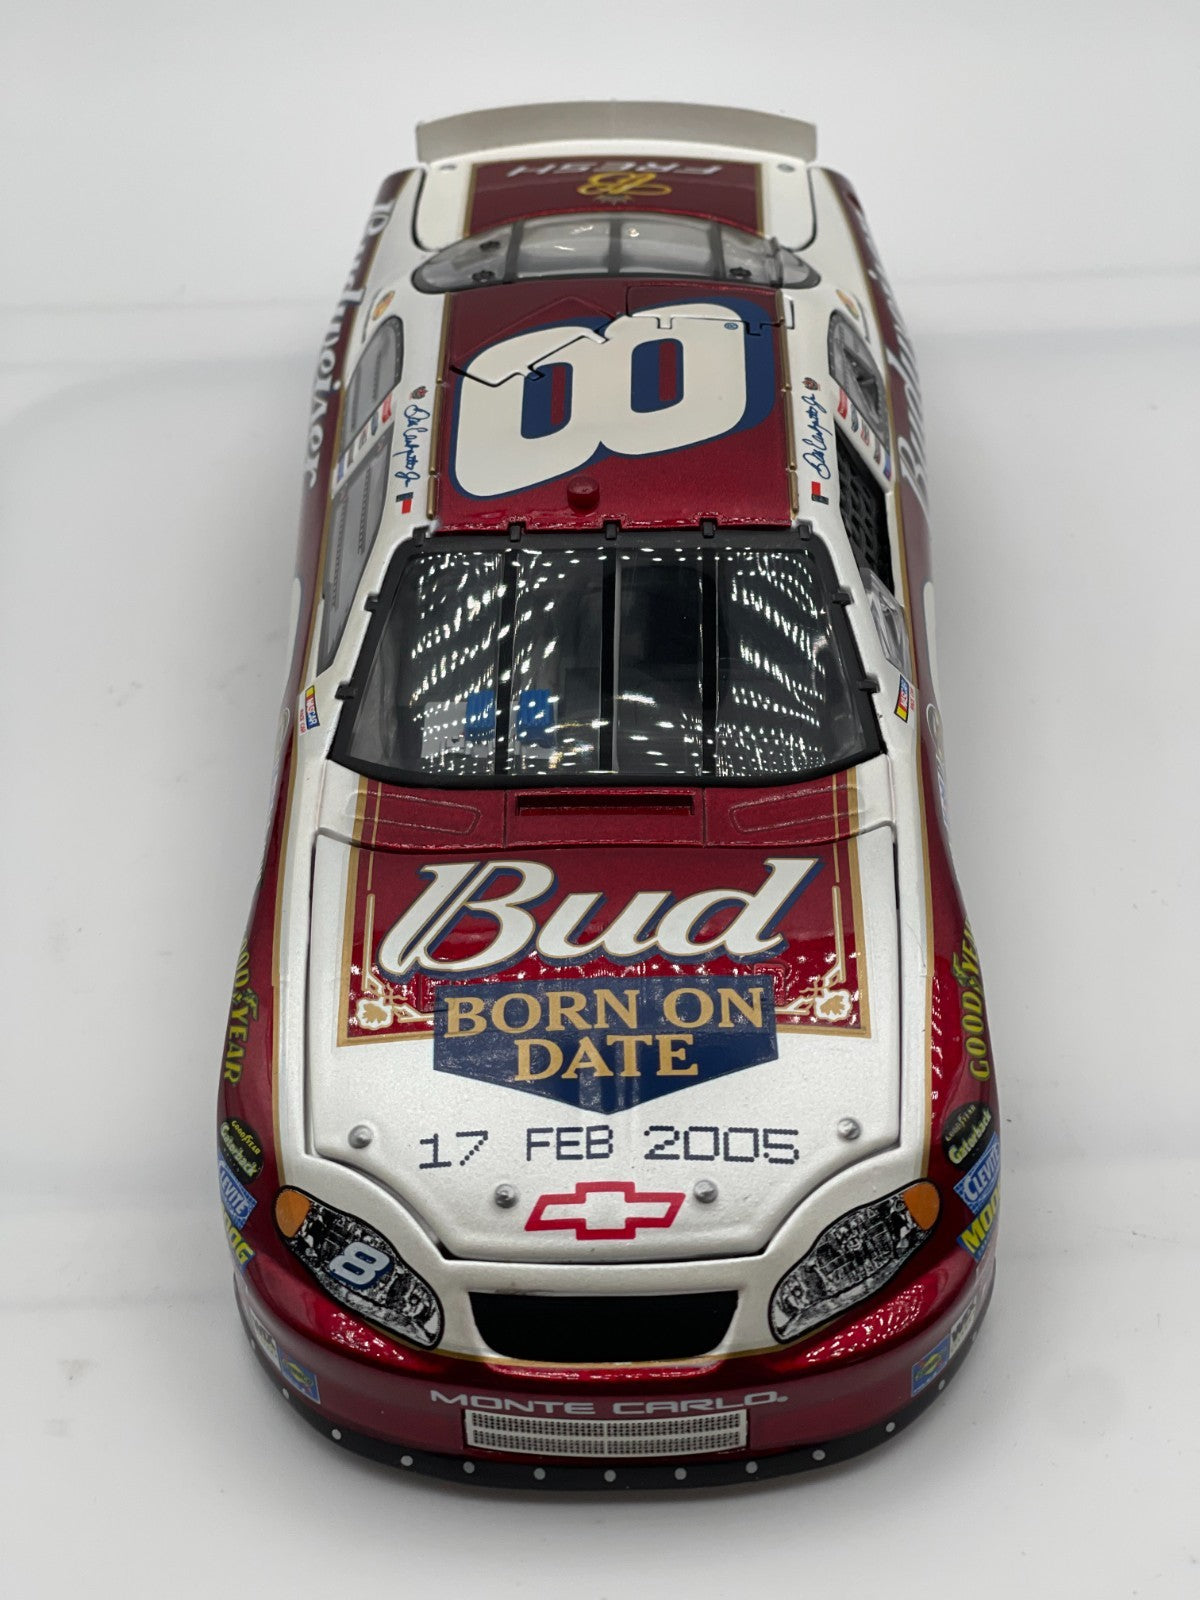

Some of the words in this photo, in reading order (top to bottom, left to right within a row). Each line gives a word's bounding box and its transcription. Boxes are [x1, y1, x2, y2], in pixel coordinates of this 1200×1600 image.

[452, 300, 757, 499] 8
[377, 856, 823, 981] Bud
[443, 988, 638, 1038] BORN
[662, 987, 764, 1028] ON
[514, 1034, 699, 1081] DATE
[418, 1130, 489, 1170] 17
[525, 1124, 615, 1161] FEB
[642, 1124, 800, 1165] 2005
[218, 1166, 249, 1215] LEVITE
[328, 1241, 393, 1289] 8
[430, 1389, 597, 1415] MONTE
